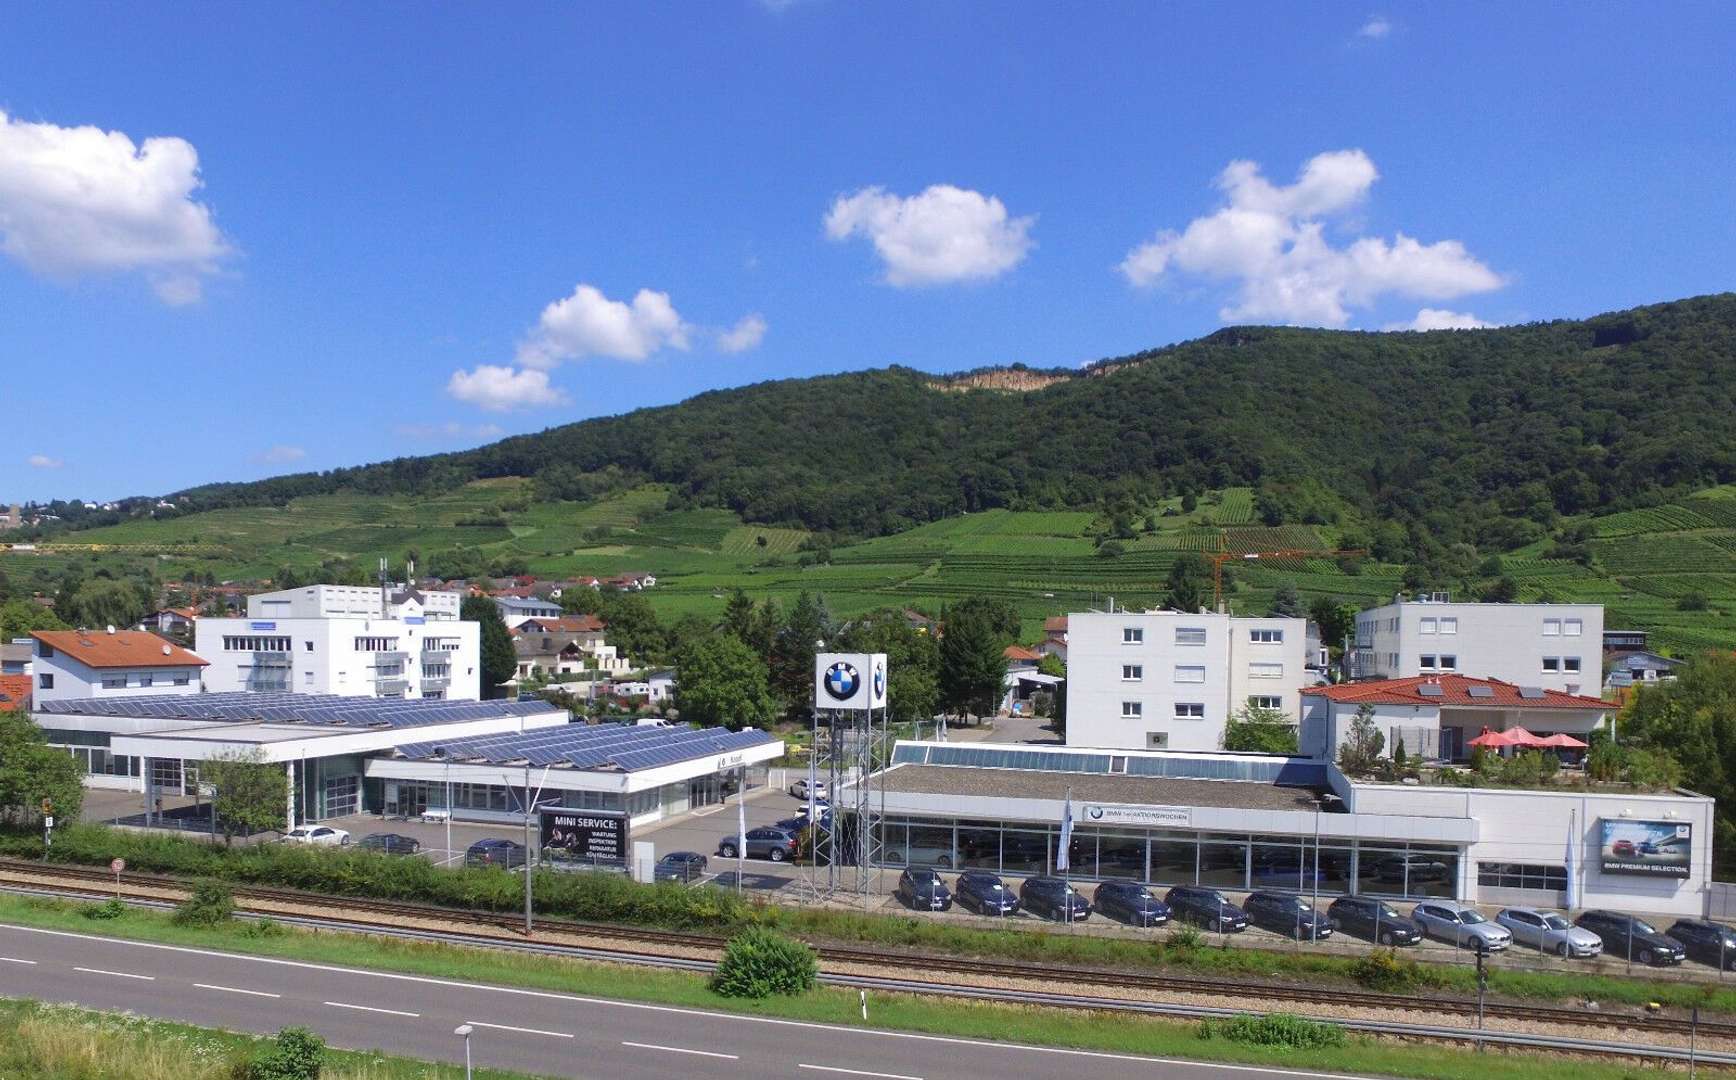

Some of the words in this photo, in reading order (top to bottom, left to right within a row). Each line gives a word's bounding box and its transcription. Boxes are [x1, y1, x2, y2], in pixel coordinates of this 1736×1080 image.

[827, 663, 857, 676] BMW
[555, 816, 576, 826] MINI
[578, 818, 617, 829] SERVICE:
[1621, 863, 1650, 871] PREMIUM
